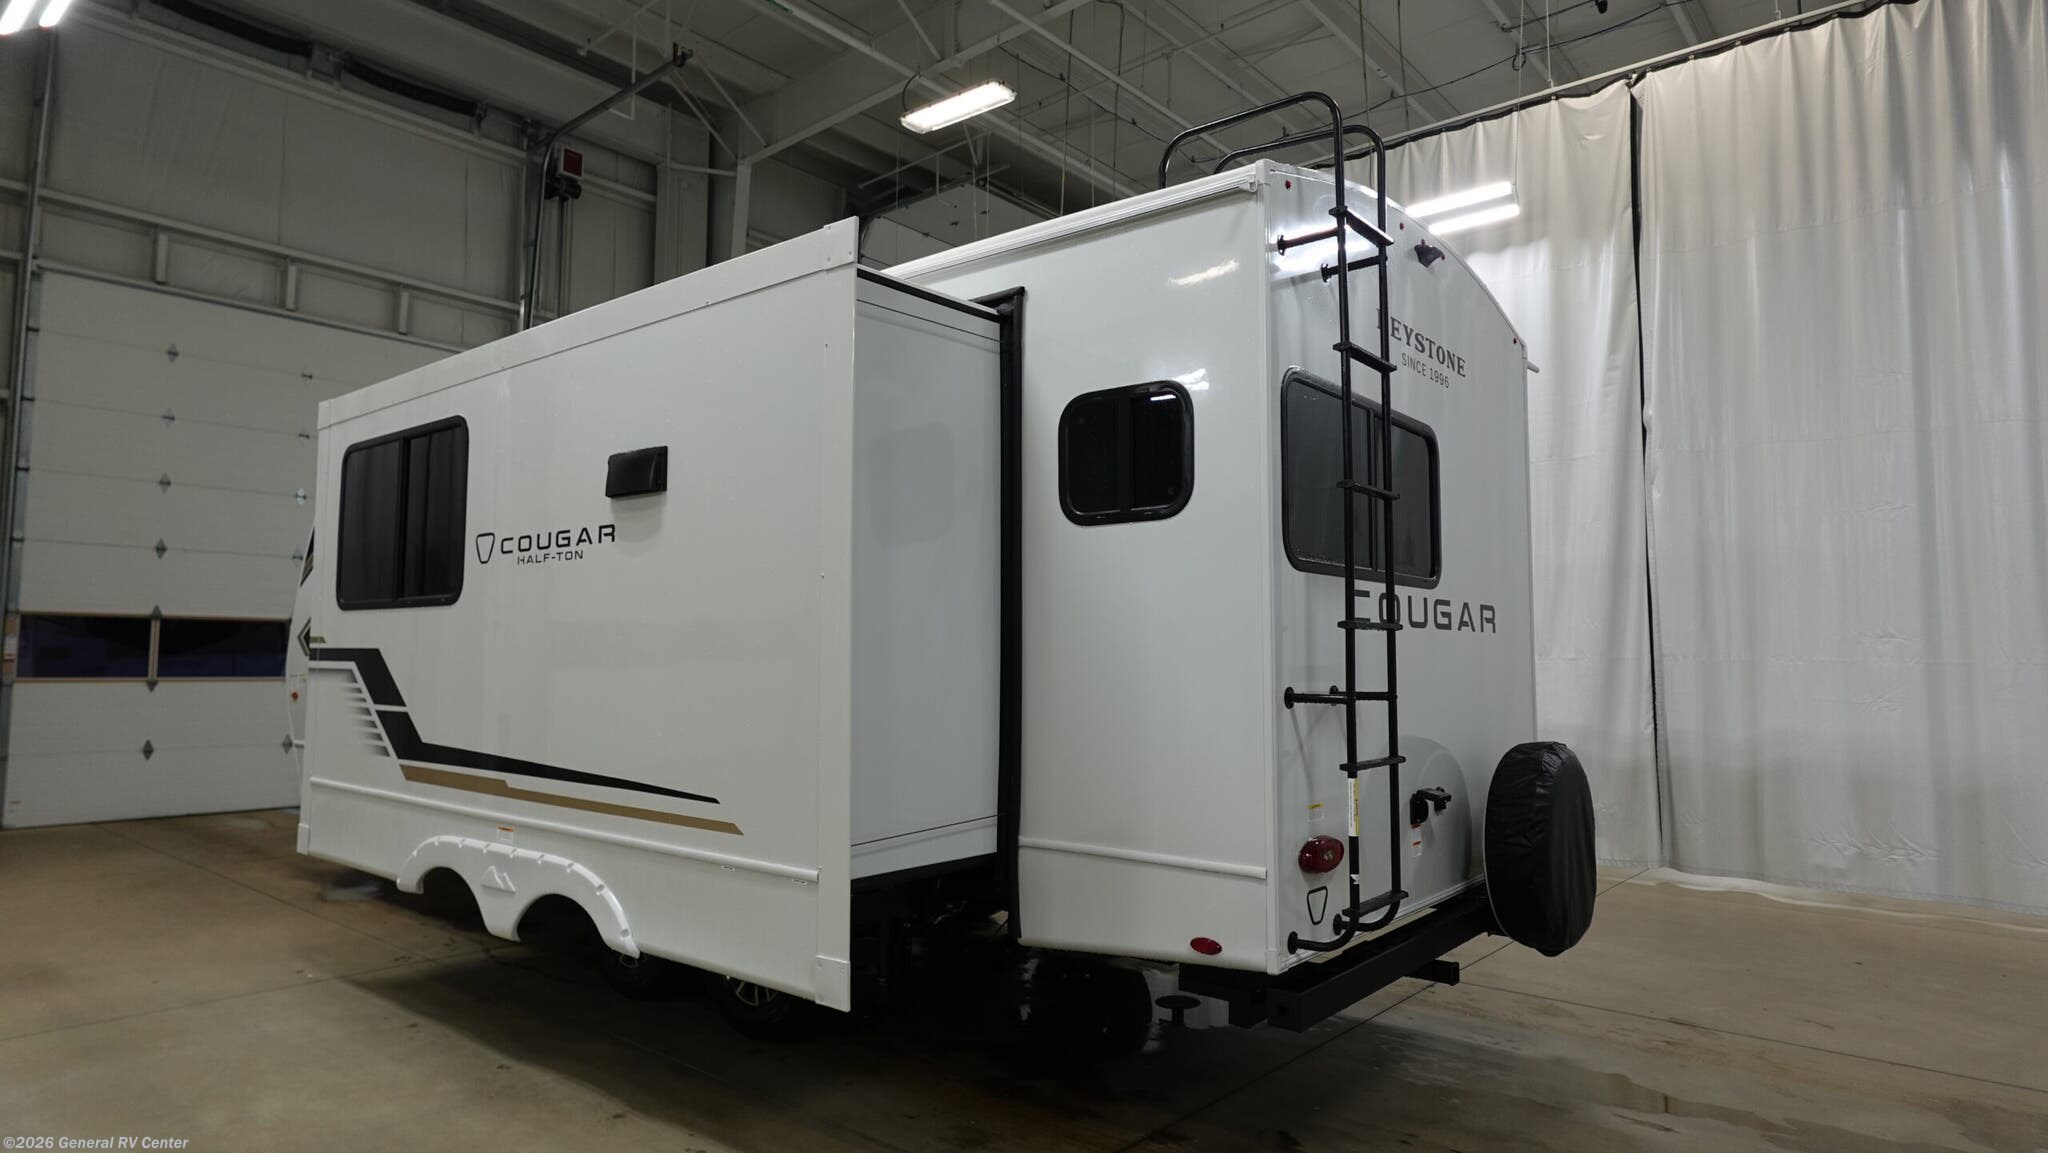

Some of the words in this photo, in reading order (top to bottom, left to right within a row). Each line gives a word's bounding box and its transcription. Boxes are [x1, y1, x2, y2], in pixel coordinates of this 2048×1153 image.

[1401, 352, 1427, 377] SINCE
[1429, 367, 1450, 389] 1996
[500, 523, 616, 554] COUGAR
[517, 550, 584, 565] HALF-TON
